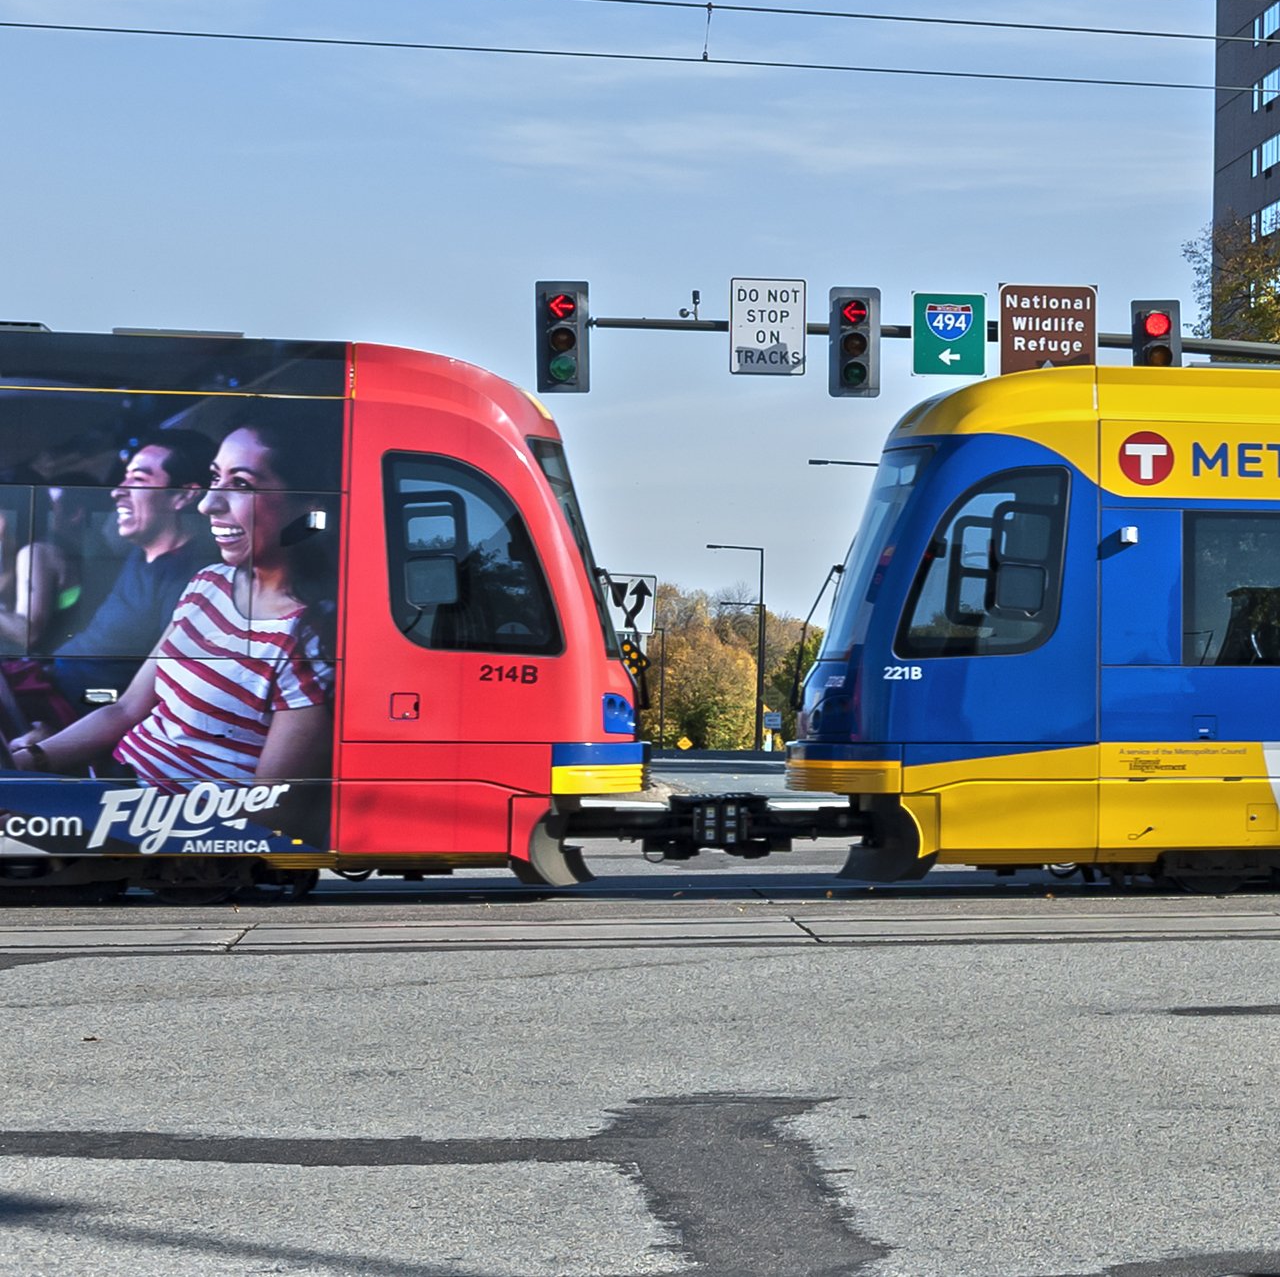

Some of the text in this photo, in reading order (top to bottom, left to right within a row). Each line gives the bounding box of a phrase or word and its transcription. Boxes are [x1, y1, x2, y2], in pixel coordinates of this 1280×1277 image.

[737, 288, 800, 304] DO NOT
[1005, 293, 1092, 310] National
[746, 309, 790, 324] STOP
[931, 314, 967, 332] 494
[1012, 315, 1085, 332] Wildlife
[755, 330, 781, 345] ON
[1013, 336, 1083, 356] Refuge
[735, 349, 800, 365] TRACKS
[479, 664, 538, 685] 214B
[883, 666, 923, 680] 221B
[0, 815, 83, 837] .com
[182, 839, 271, 854] AMERICA
